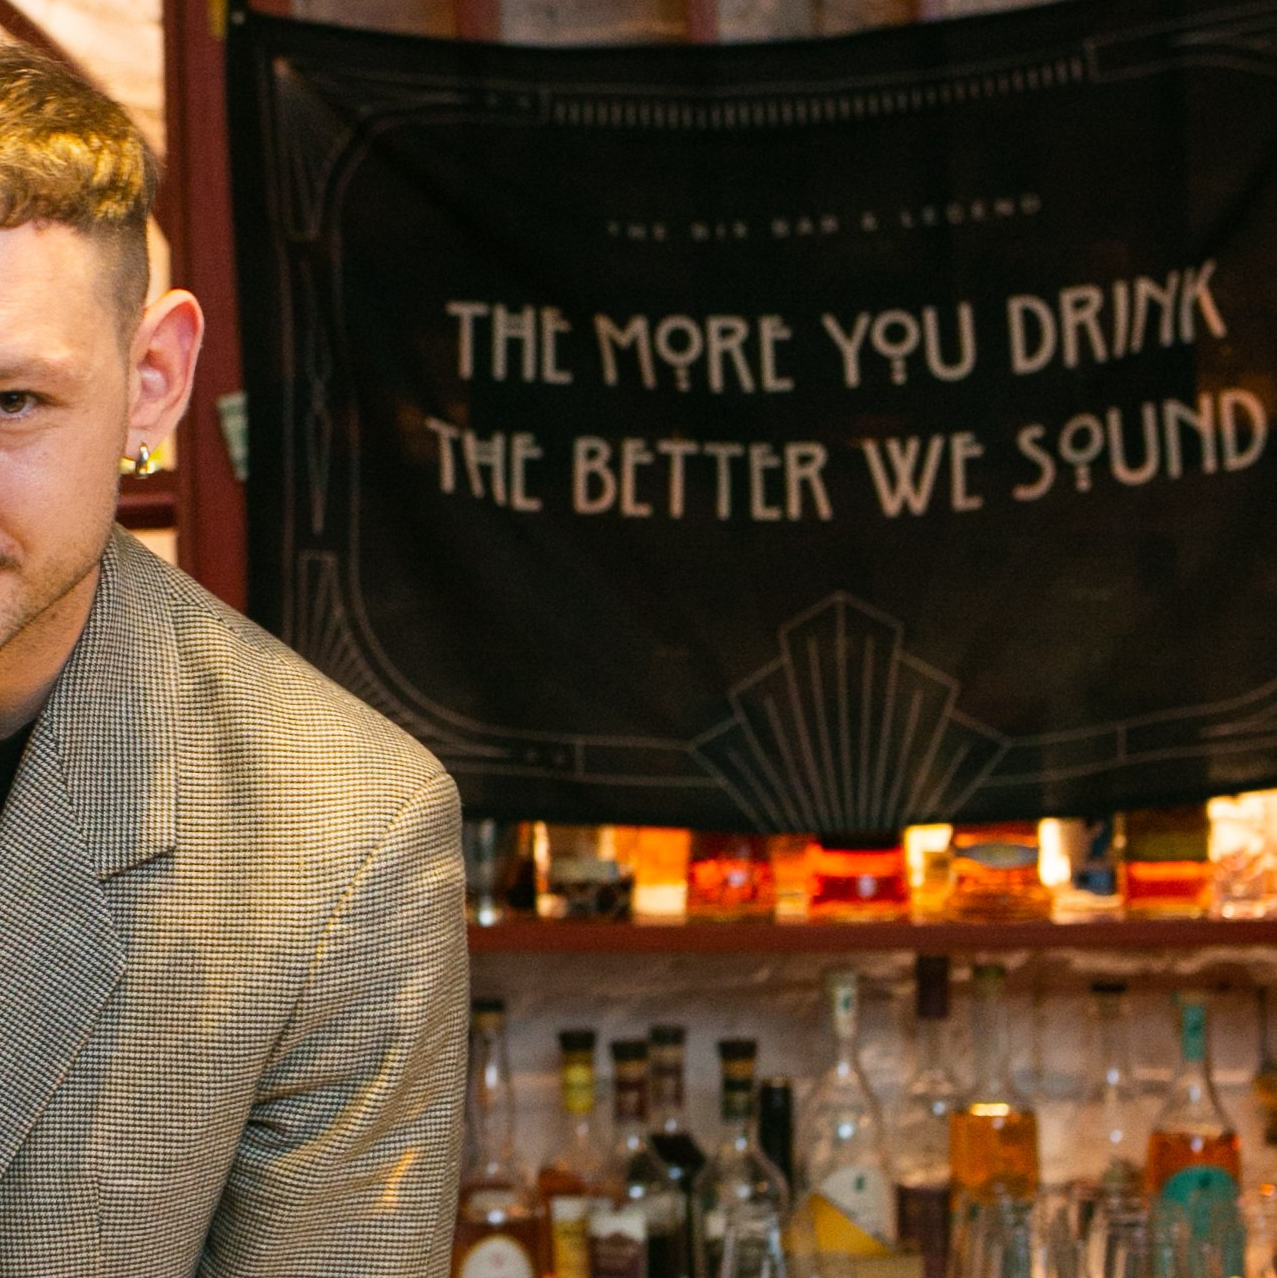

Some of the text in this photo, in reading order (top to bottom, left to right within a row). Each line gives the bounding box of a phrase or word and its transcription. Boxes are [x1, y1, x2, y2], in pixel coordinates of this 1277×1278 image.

[445, 258, 1228, 393] THE MORE YOU DRINK
[424, 387, 1268, 521] THE BETTER WE SOUND
